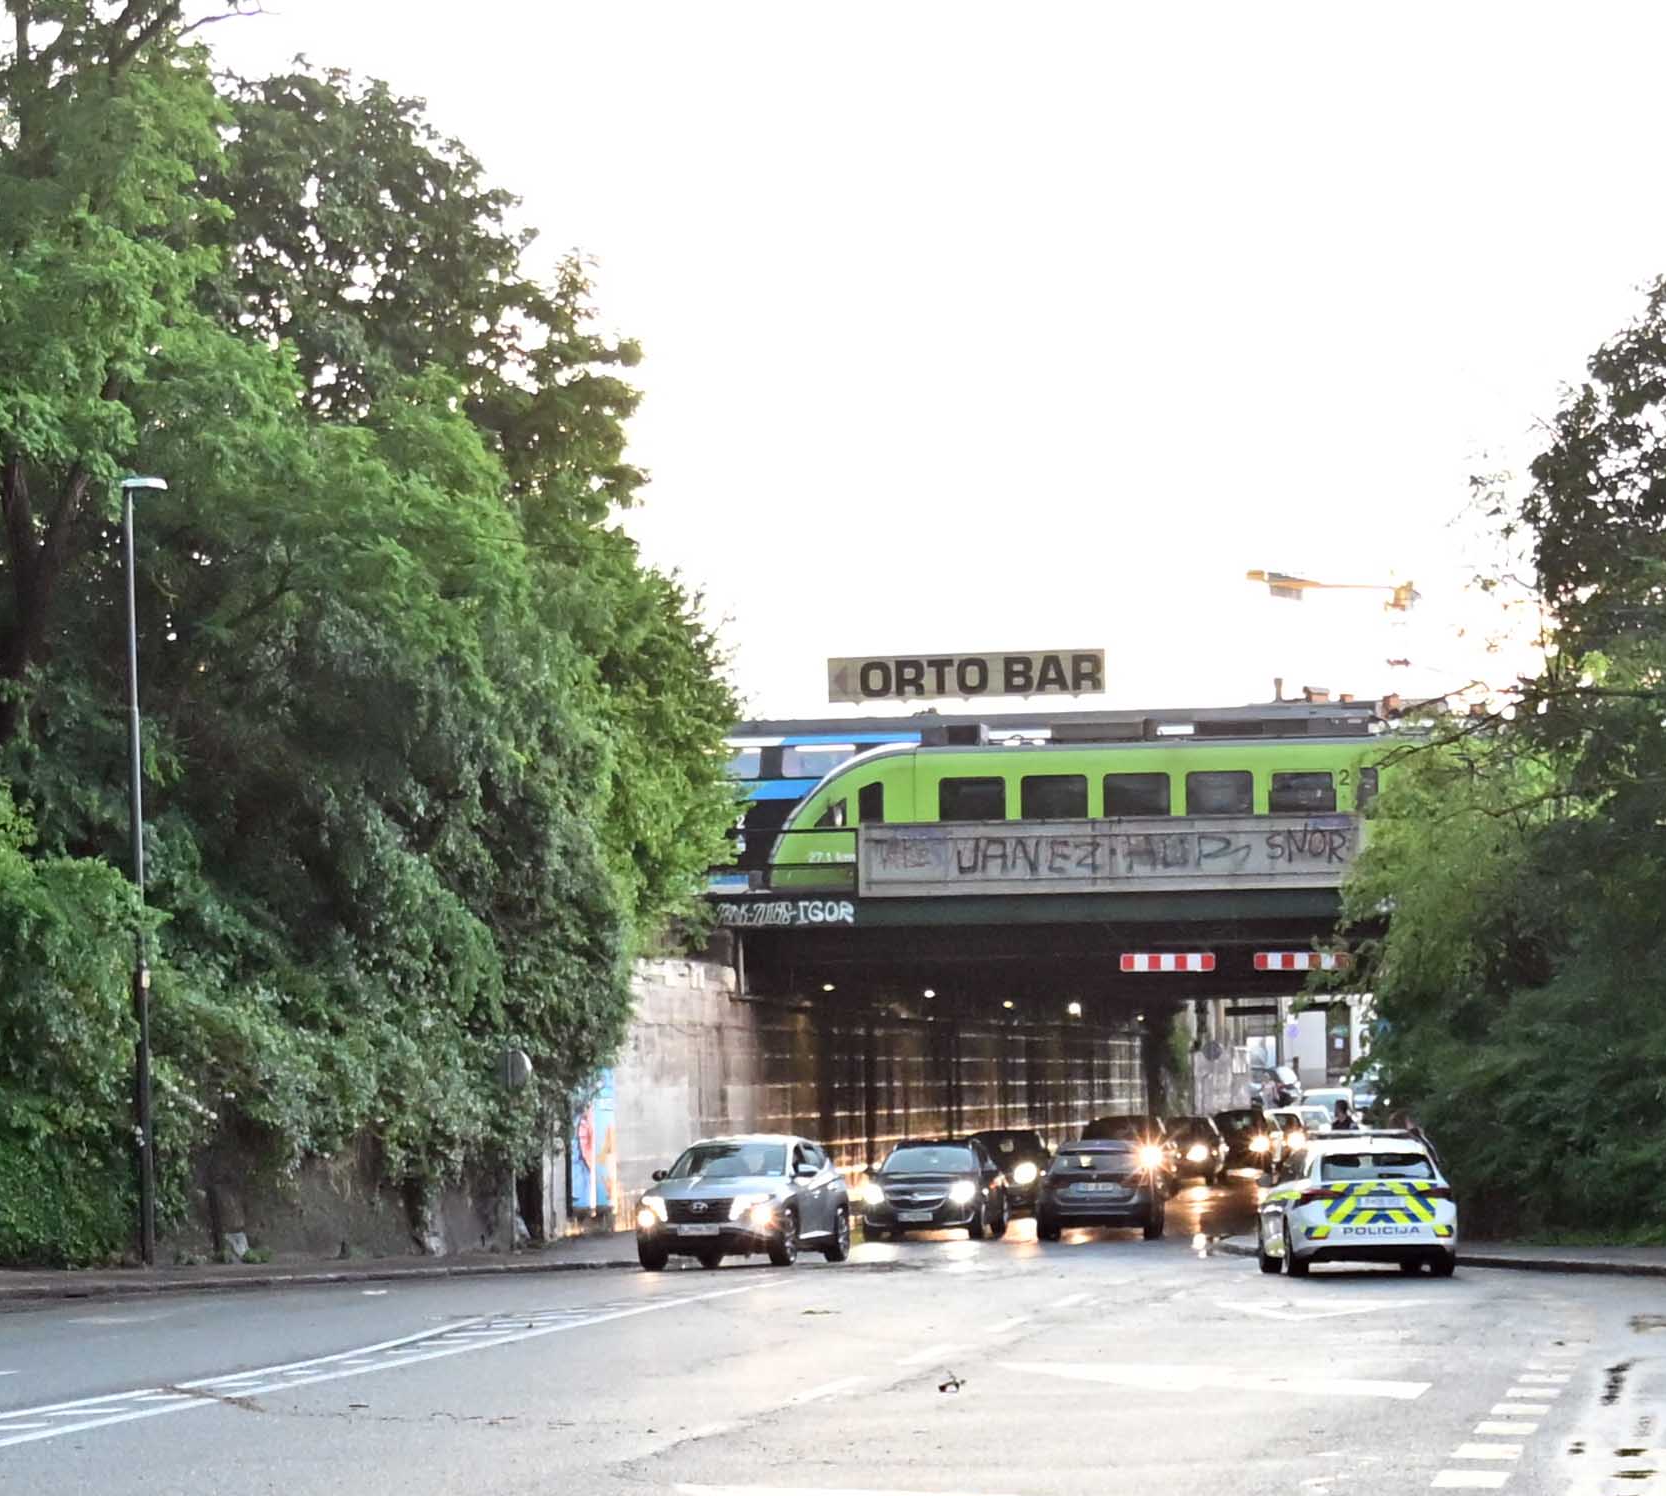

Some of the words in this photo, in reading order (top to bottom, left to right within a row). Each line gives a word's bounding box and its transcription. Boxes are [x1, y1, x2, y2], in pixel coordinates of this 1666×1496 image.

[859, 657, 989, 698] ORTO
[1004, 654, 1103, 693] BAR
[1338, 769, 1350, 786] 2
[1343, 1226, 1420, 1236] POLICIJA
